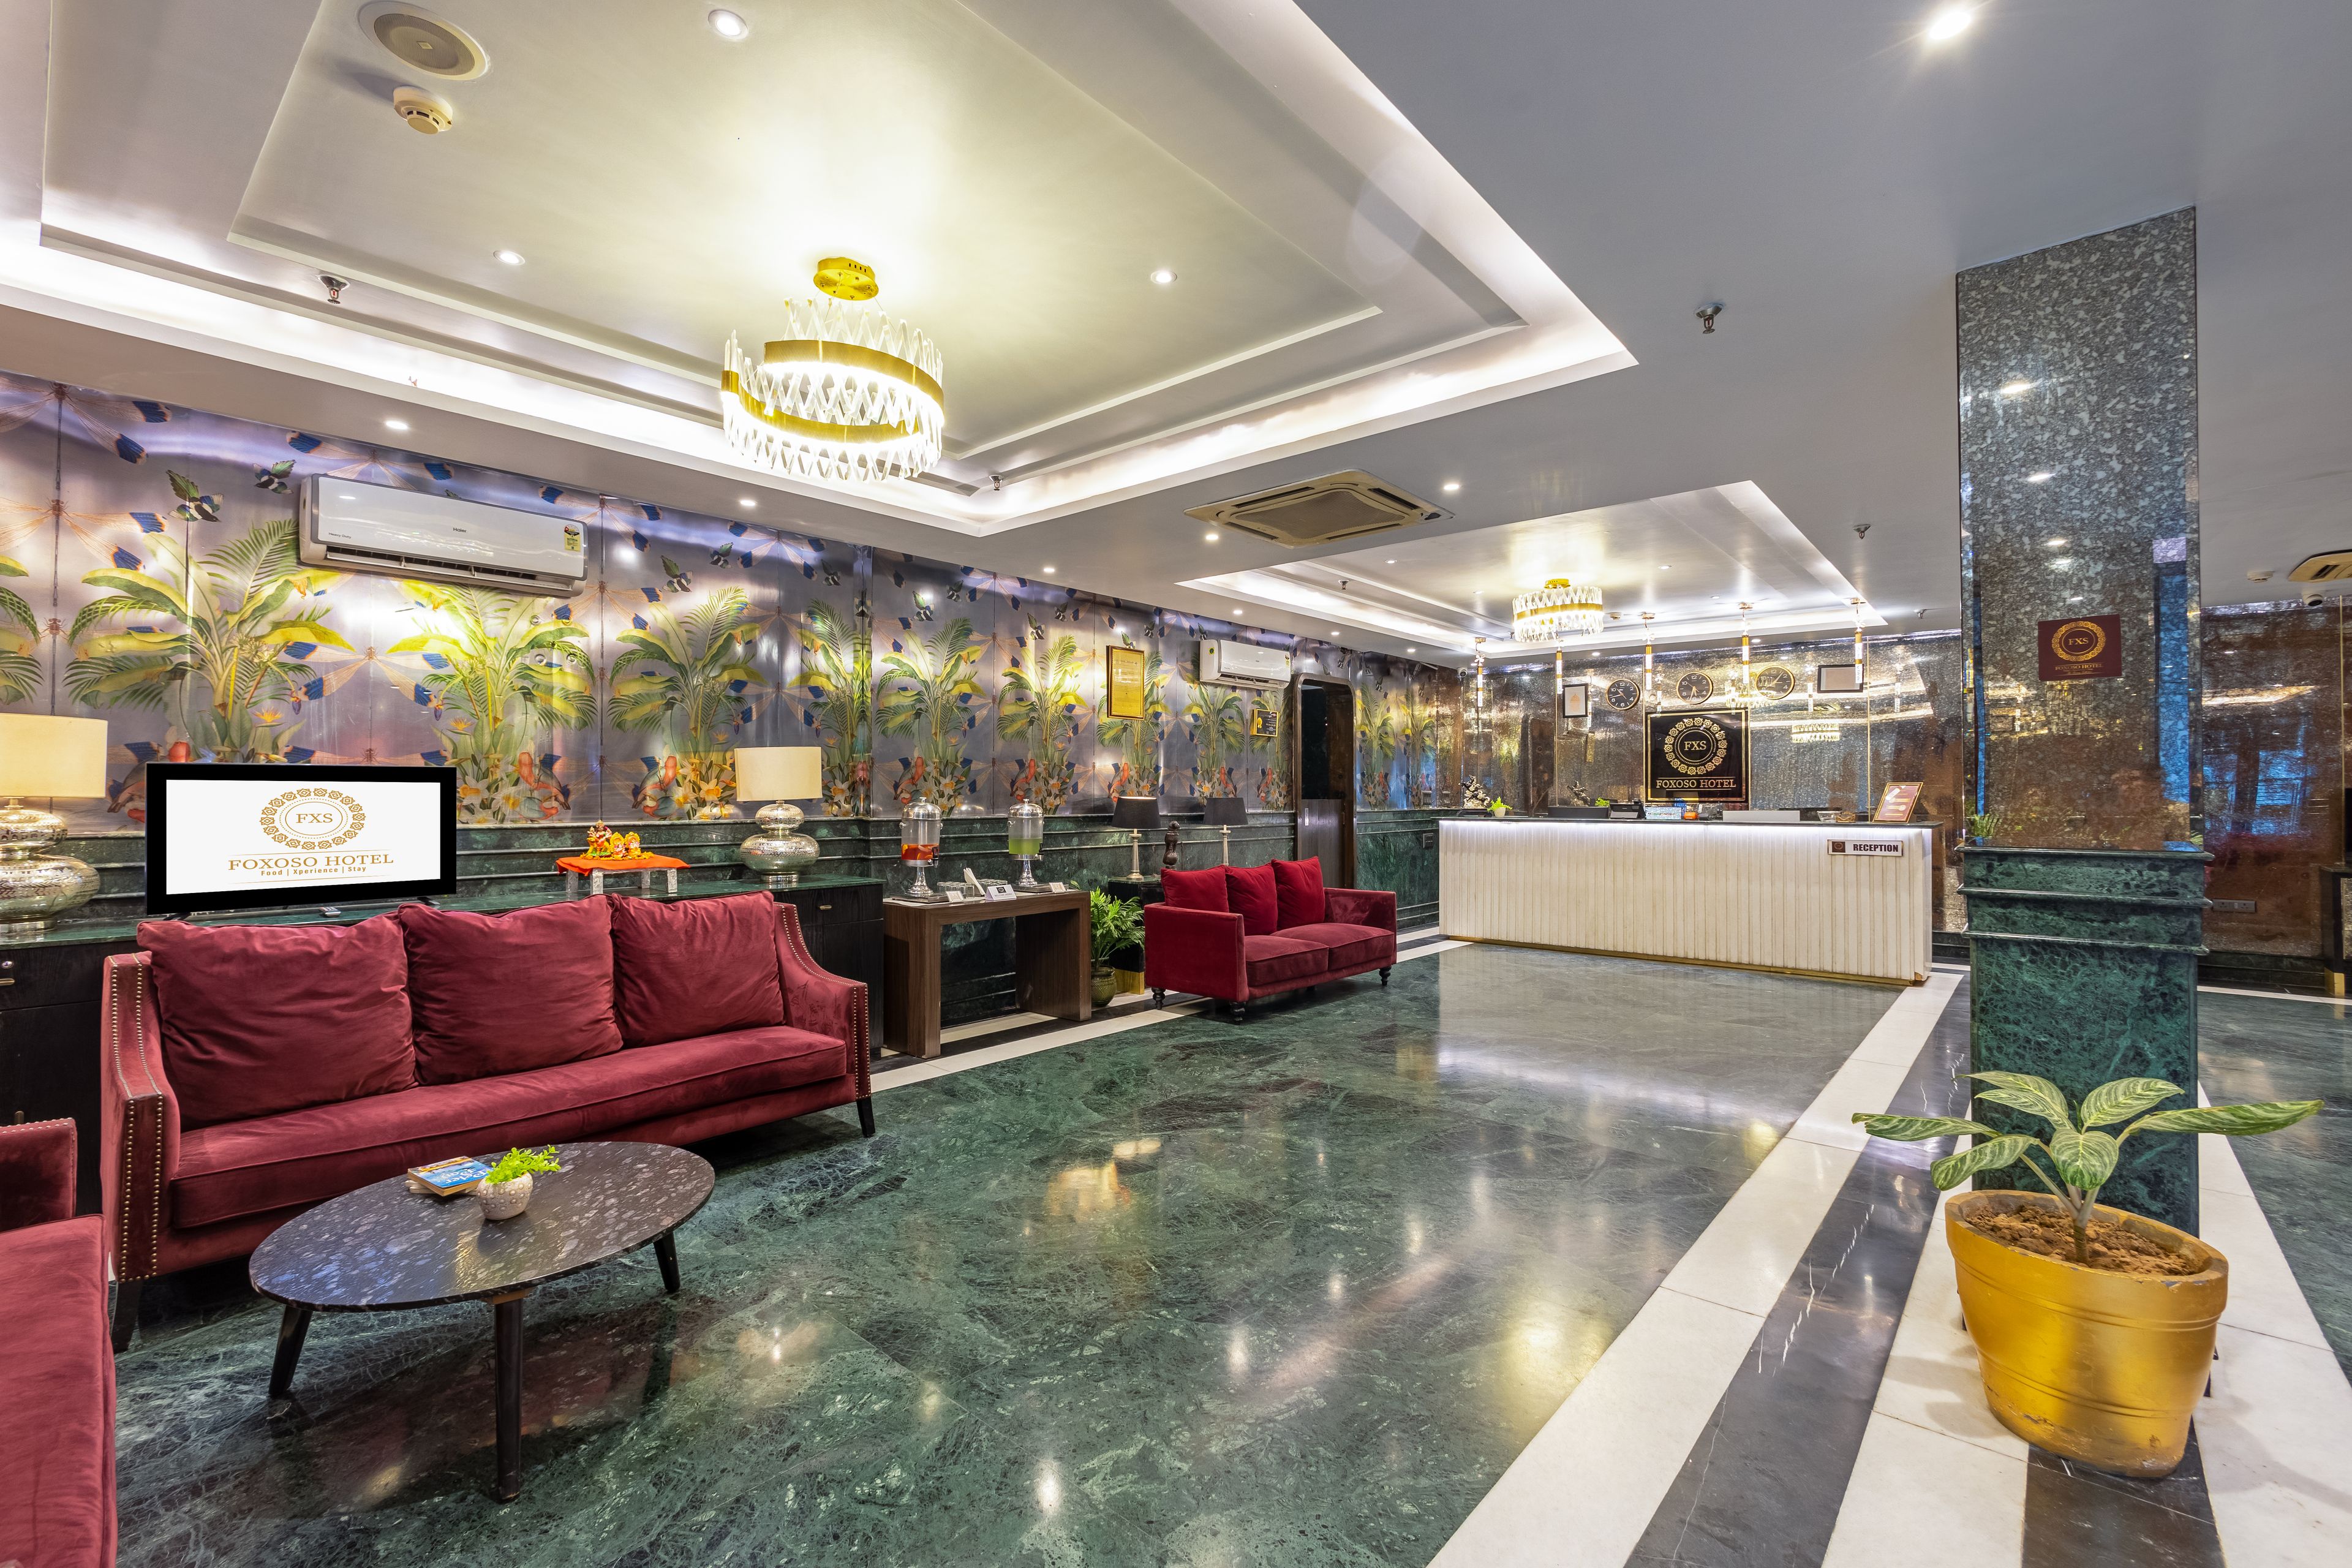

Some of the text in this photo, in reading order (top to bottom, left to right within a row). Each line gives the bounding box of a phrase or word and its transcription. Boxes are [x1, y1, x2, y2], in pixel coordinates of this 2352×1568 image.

[1684, 741, 1707, 750] FXS
[1656, 779, 1736, 788] FOXOSO HOTEL
[295, 813, 333, 824] FXS
[1853, 843, 1899, 853] RECEPTION
[228, 854, 394, 870] FOXOSO HOTEL
[293, 867, 338, 875] Xperience
